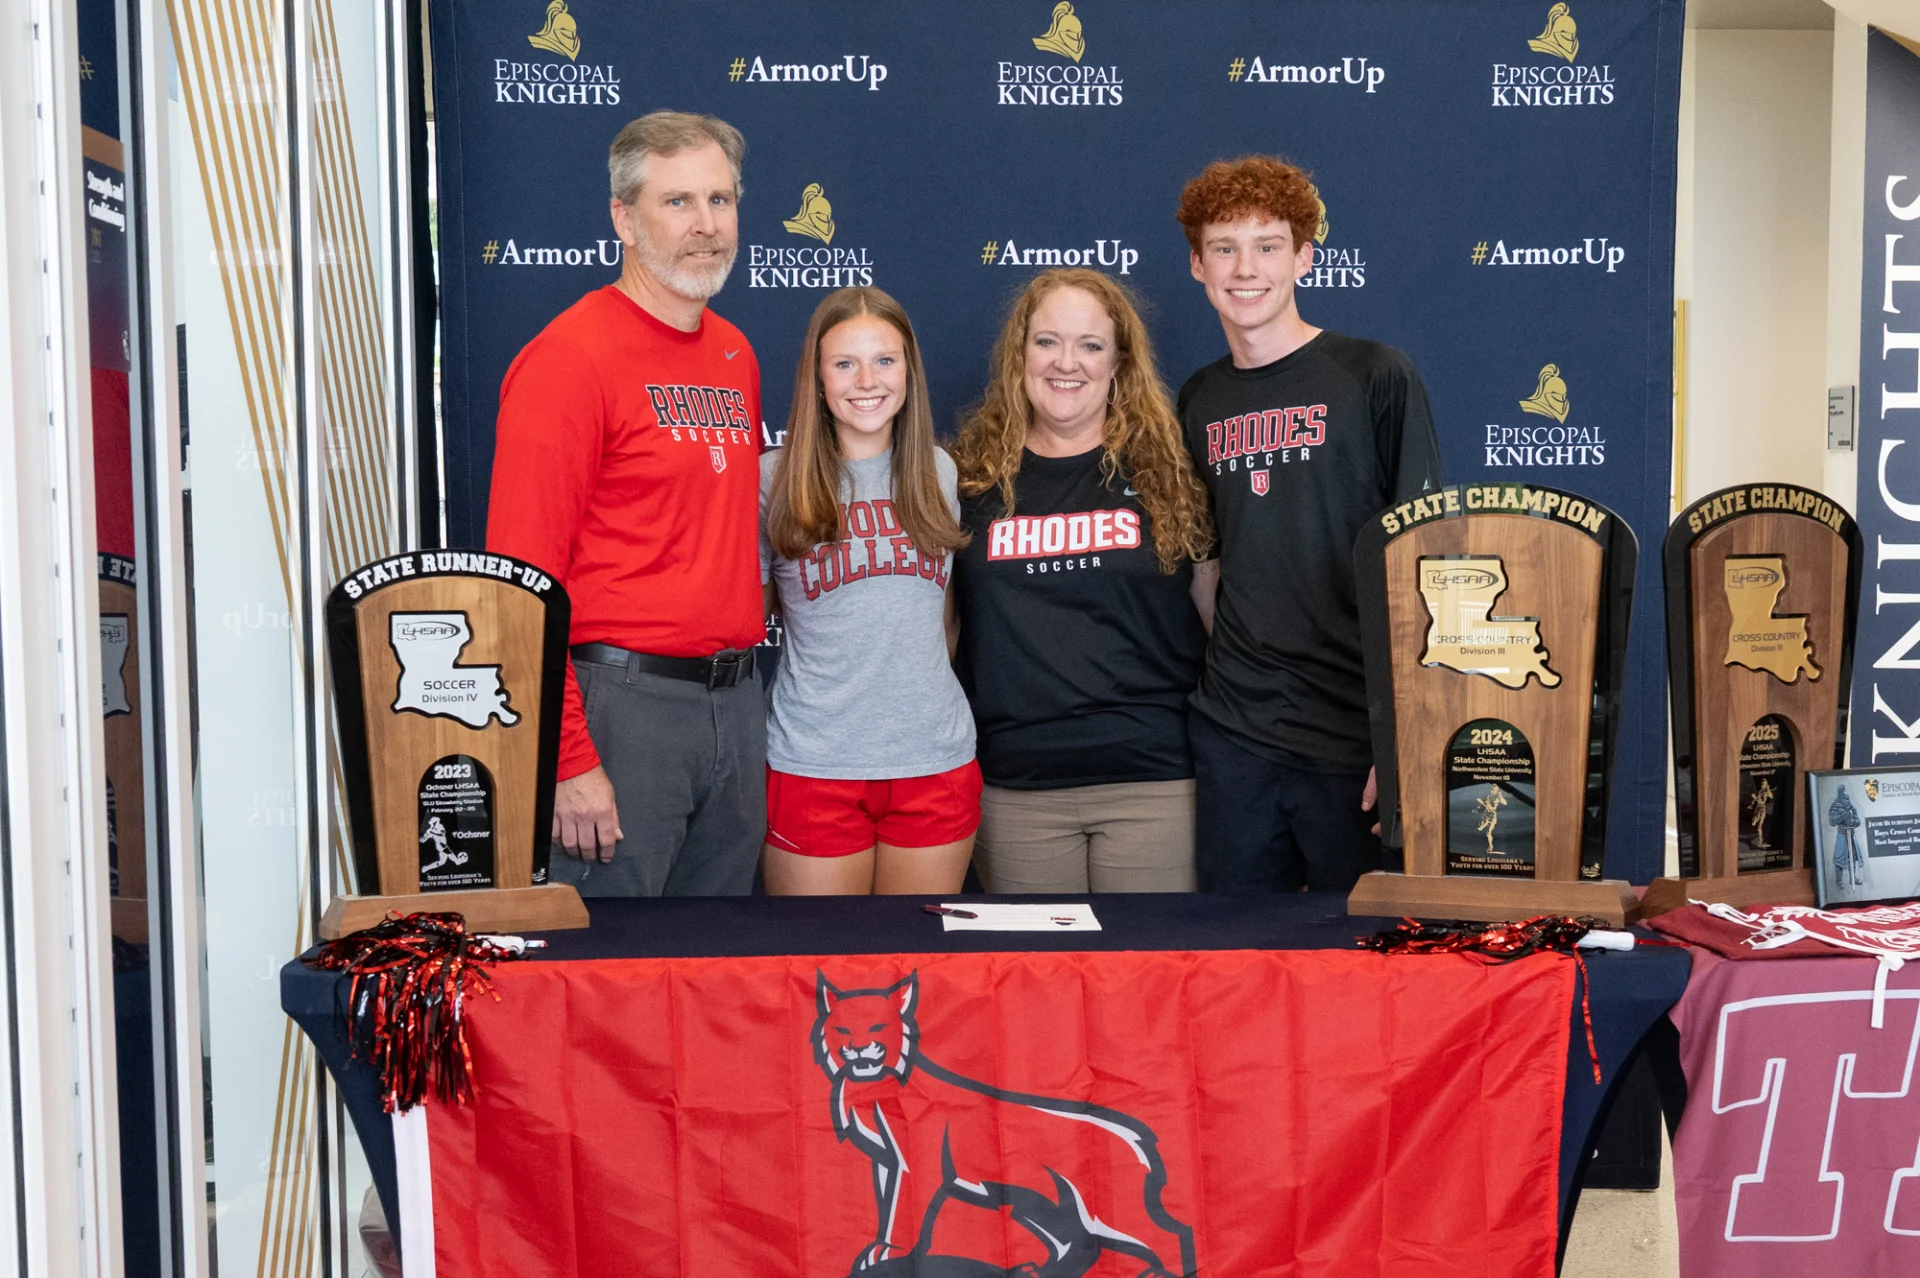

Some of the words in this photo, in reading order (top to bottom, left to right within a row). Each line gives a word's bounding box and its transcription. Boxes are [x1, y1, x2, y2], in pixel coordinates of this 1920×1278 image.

[495, 59, 620, 83] EPISCOPAL
[728, 55, 887, 91] #ArmorUp
[997, 62, 1124, 84] EPISCOPAL
[1228, 56, 1385, 93] #ArmorUp
[1492, 64, 1615, 85] EPISCOPAL
[495, 83, 620, 105] KNIGHTS
[997, 84, 1123, 106] KNIGHTS
[1491, 85, 1614, 107] KNIGHTS
[482, 239, 623, 267] #ArmorU
[749, 245, 873, 267] EPISCOPAL
[981, 240, 1139, 275] #ArmorUp
[1471, 239, 1625, 272] #ArmorUp
[749, 267, 873, 288] KNIGHTS
[1295, 267, 1365, 288] GHTS
[645, 385, 751, 432] RHODES
[671, 429, 751, 446] SOCCER
[1206, 404, 1327, 466] RHODES
[1485, 425, 1605, 445] EPISCOPAL
[1216, 447, 1310, 476] SOCCER
[1485, 445, 1605, 466] KNIGHTS
[1381, 490, 1460, 535] STATE
[1466, 487, 1606, 533] CHAMPION
[1688, 490, 1746, 534] STATE
[1750, 487, 1845, 533] CHAMPION
[988, 509, 1140, 560] RHODES
[344, 556, 415, 599] STATE
[420, 552, 552, 593] RUNNER-UP
[800, 536, 948, 601] COLLEGE
[1026, 556, 1101, 575] SOCCER
[1434, 635, 1472, 645] CROSS
[1475, 635, 1532, 645] COUNTRY
[1732, 633, 1762, 642] CROSS
[1763, 631, 1801, 641] COUNTRY
[1460, 647, 1496, 655] Division
[423, 680, 476, 690] SOCCER
[422, 693, 464, 703] Division
[466, 693, 478, 702] IV
[1471, 729, 1513, 745] 2024
[1749, 724, 1779, 741] 2025
[434, 764, 471, 779] 2023
[1476, 757, 1531, 766] Championship
[456, 831, 490, 839] Ochsner
